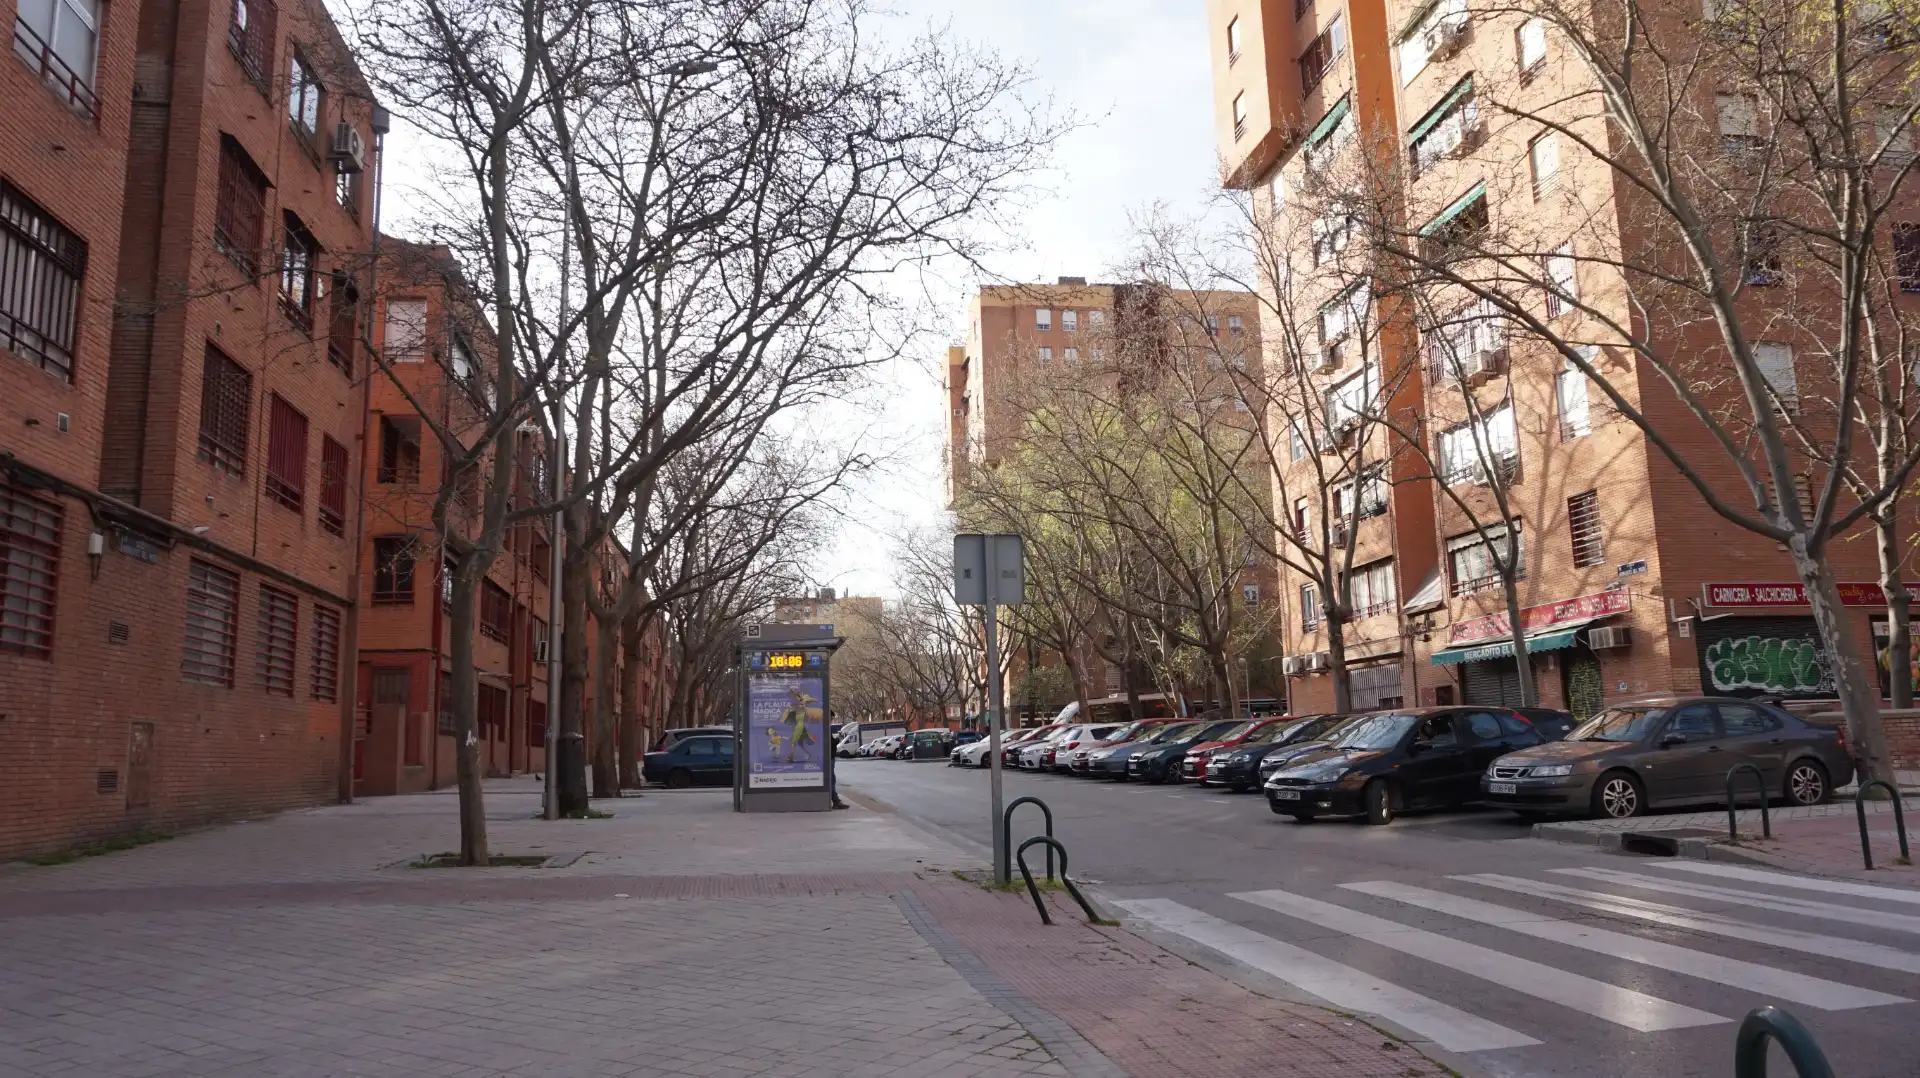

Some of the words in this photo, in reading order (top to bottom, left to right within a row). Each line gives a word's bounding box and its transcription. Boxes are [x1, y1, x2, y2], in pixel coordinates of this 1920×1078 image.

[1713, 587, 1751, 602] CARNICERIA
[1755, 587, 1798, 602] SALCHICHERIA
[1463, 647, 1500, 661] MERCADITO
[1502, 645, 1510, 655] EL
